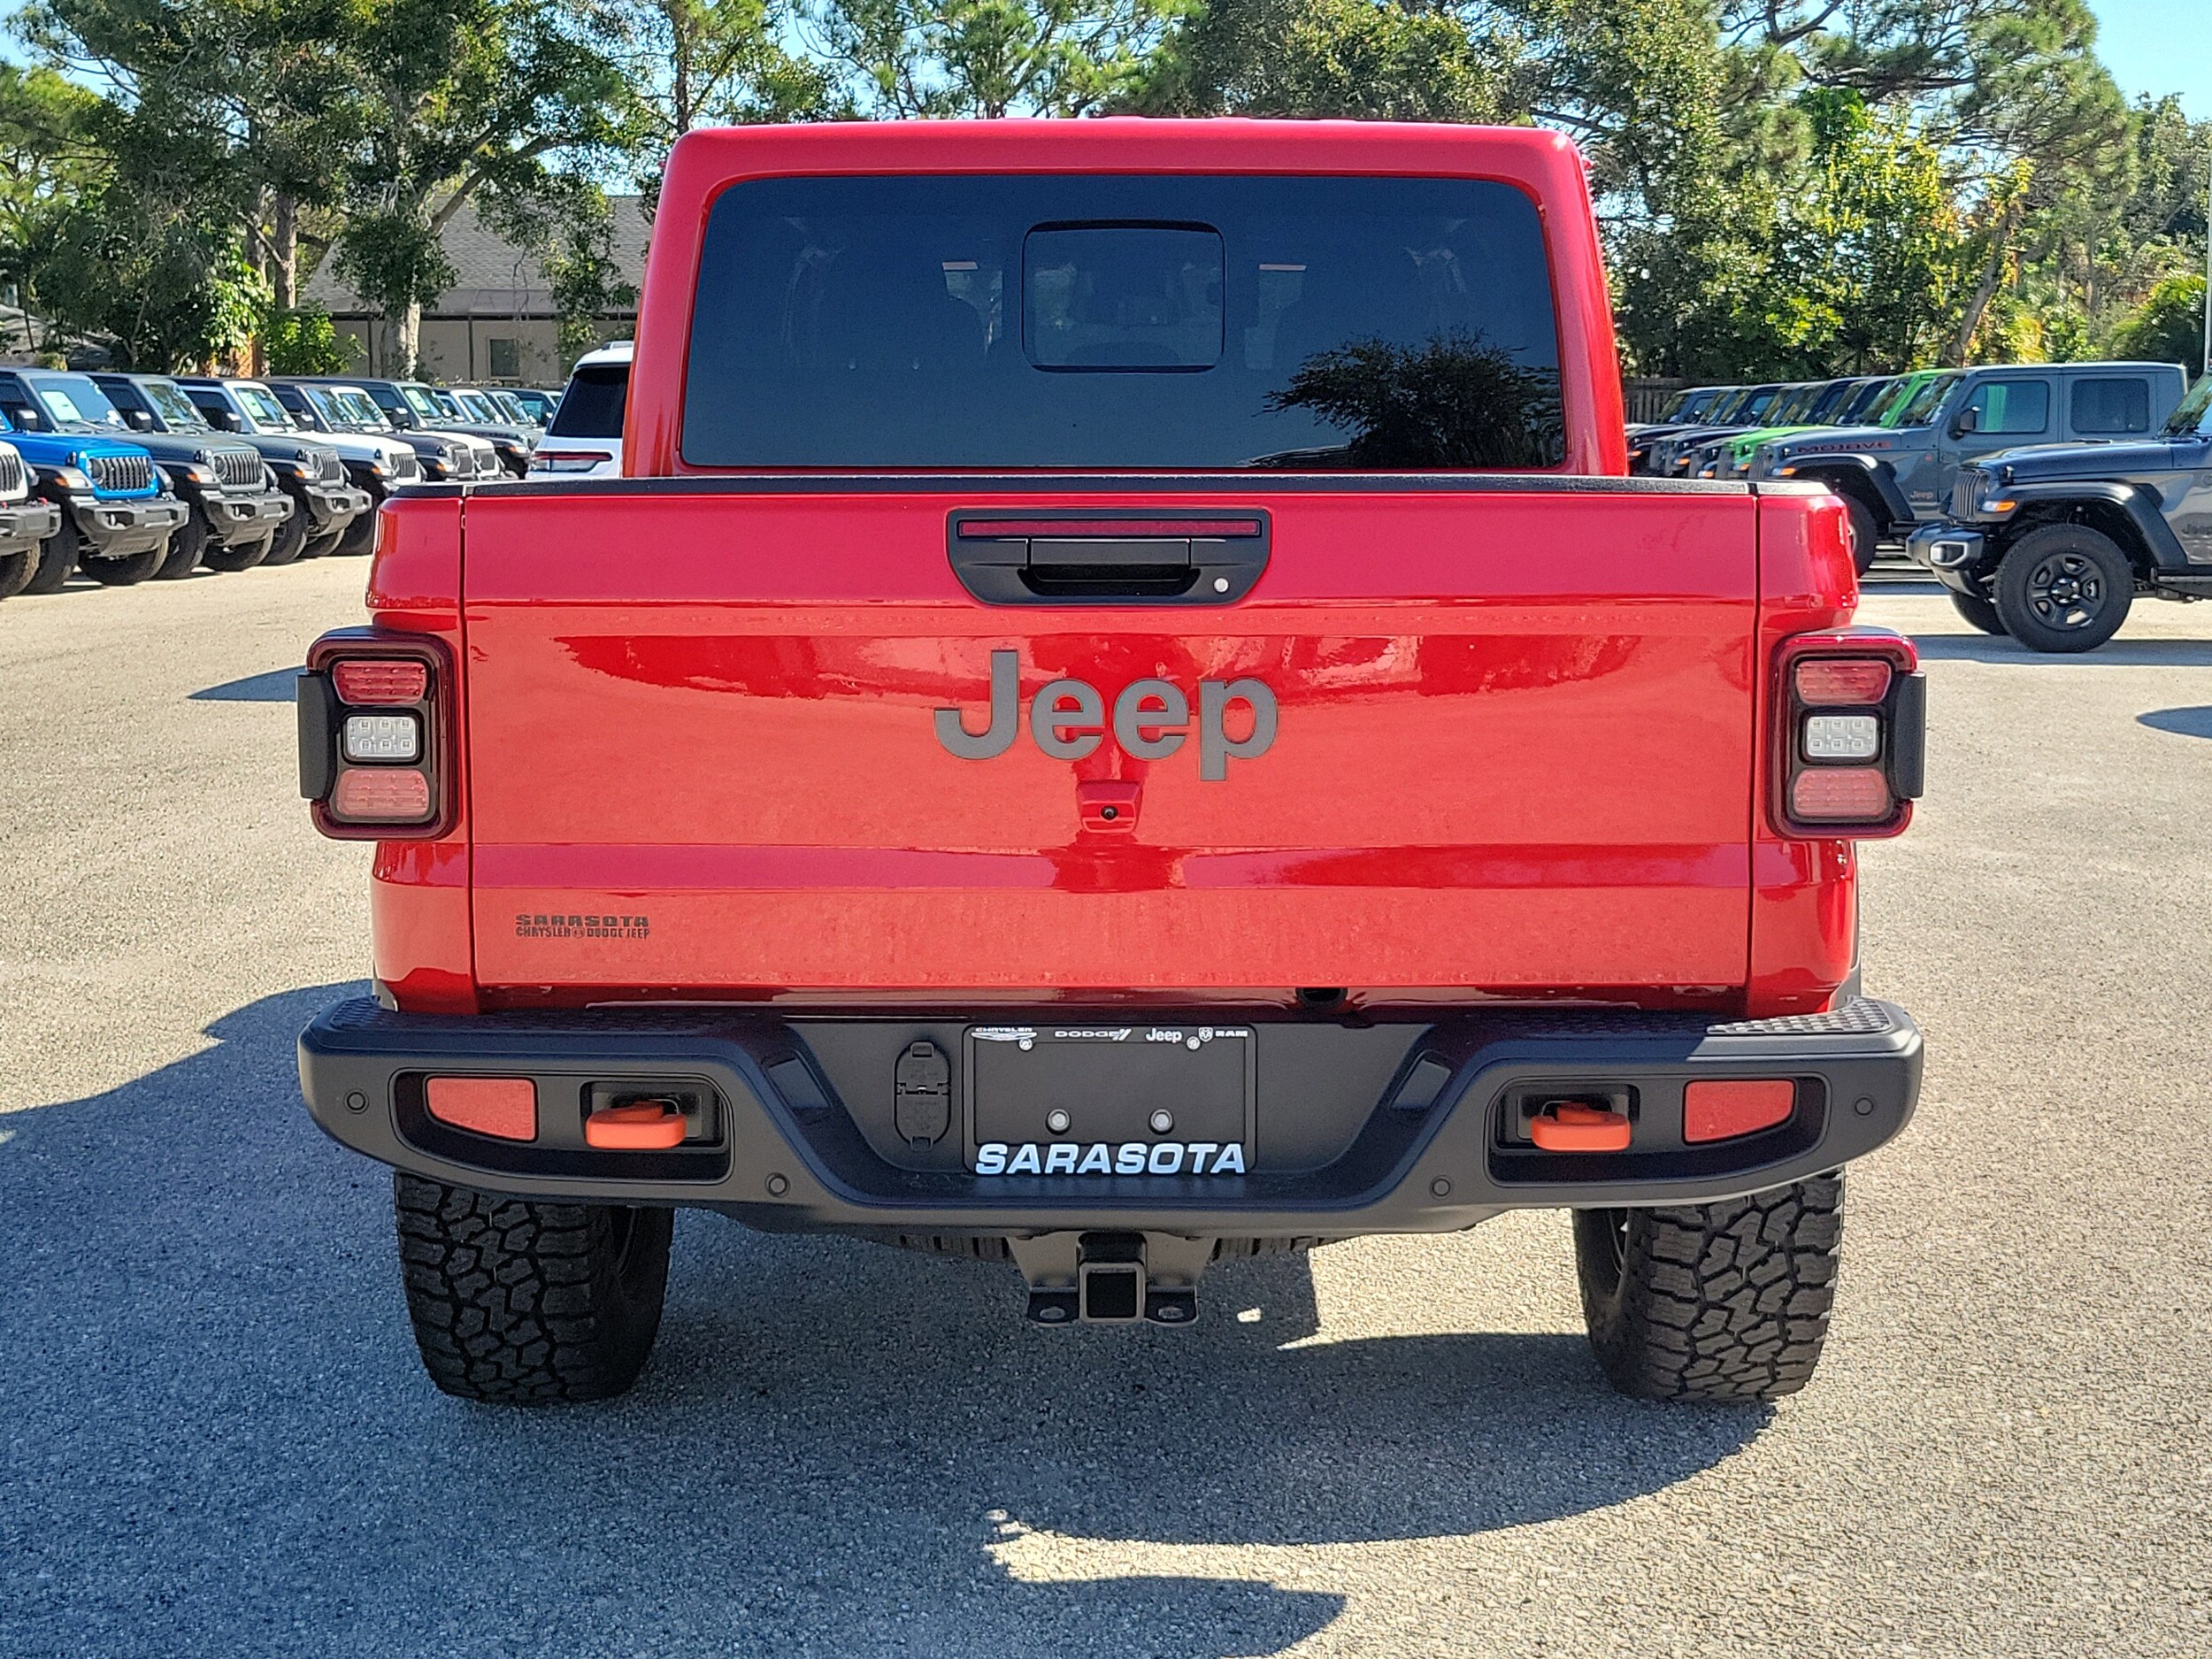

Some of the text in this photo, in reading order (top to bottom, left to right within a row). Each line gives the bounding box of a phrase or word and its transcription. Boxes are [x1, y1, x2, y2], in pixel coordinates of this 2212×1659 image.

[1909, 490, 1933, 500] Jeep
[933, 649, 1279, 782] Jeep
[516, 914, 649, 927] SARASOTA
[516, 926, 650, 940] CHRYSLER DODGE JEEP
[1054, 1030, 1122, 1040] DODGE
[1146, 1027, 1183, 1044] Jeep
[975, 1142, 1246, 1175] SARASOTA
